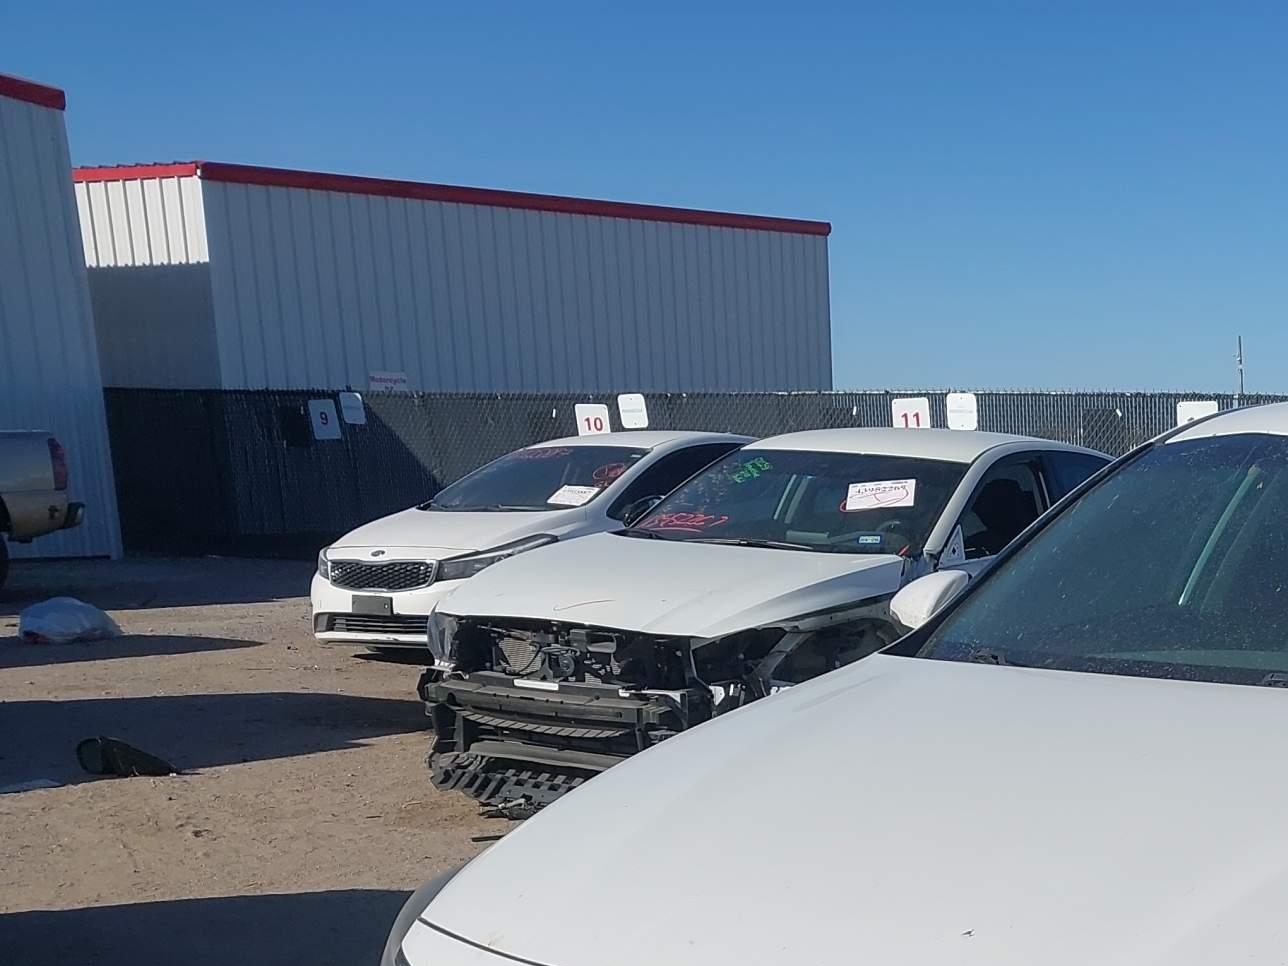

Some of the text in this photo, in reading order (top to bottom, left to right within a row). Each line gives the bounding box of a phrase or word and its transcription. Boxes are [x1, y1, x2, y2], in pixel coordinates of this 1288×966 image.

[319, 411, 329, 425] 9
[584, 416, 604, 432] 10
[901, 412, 920, 428] 11
